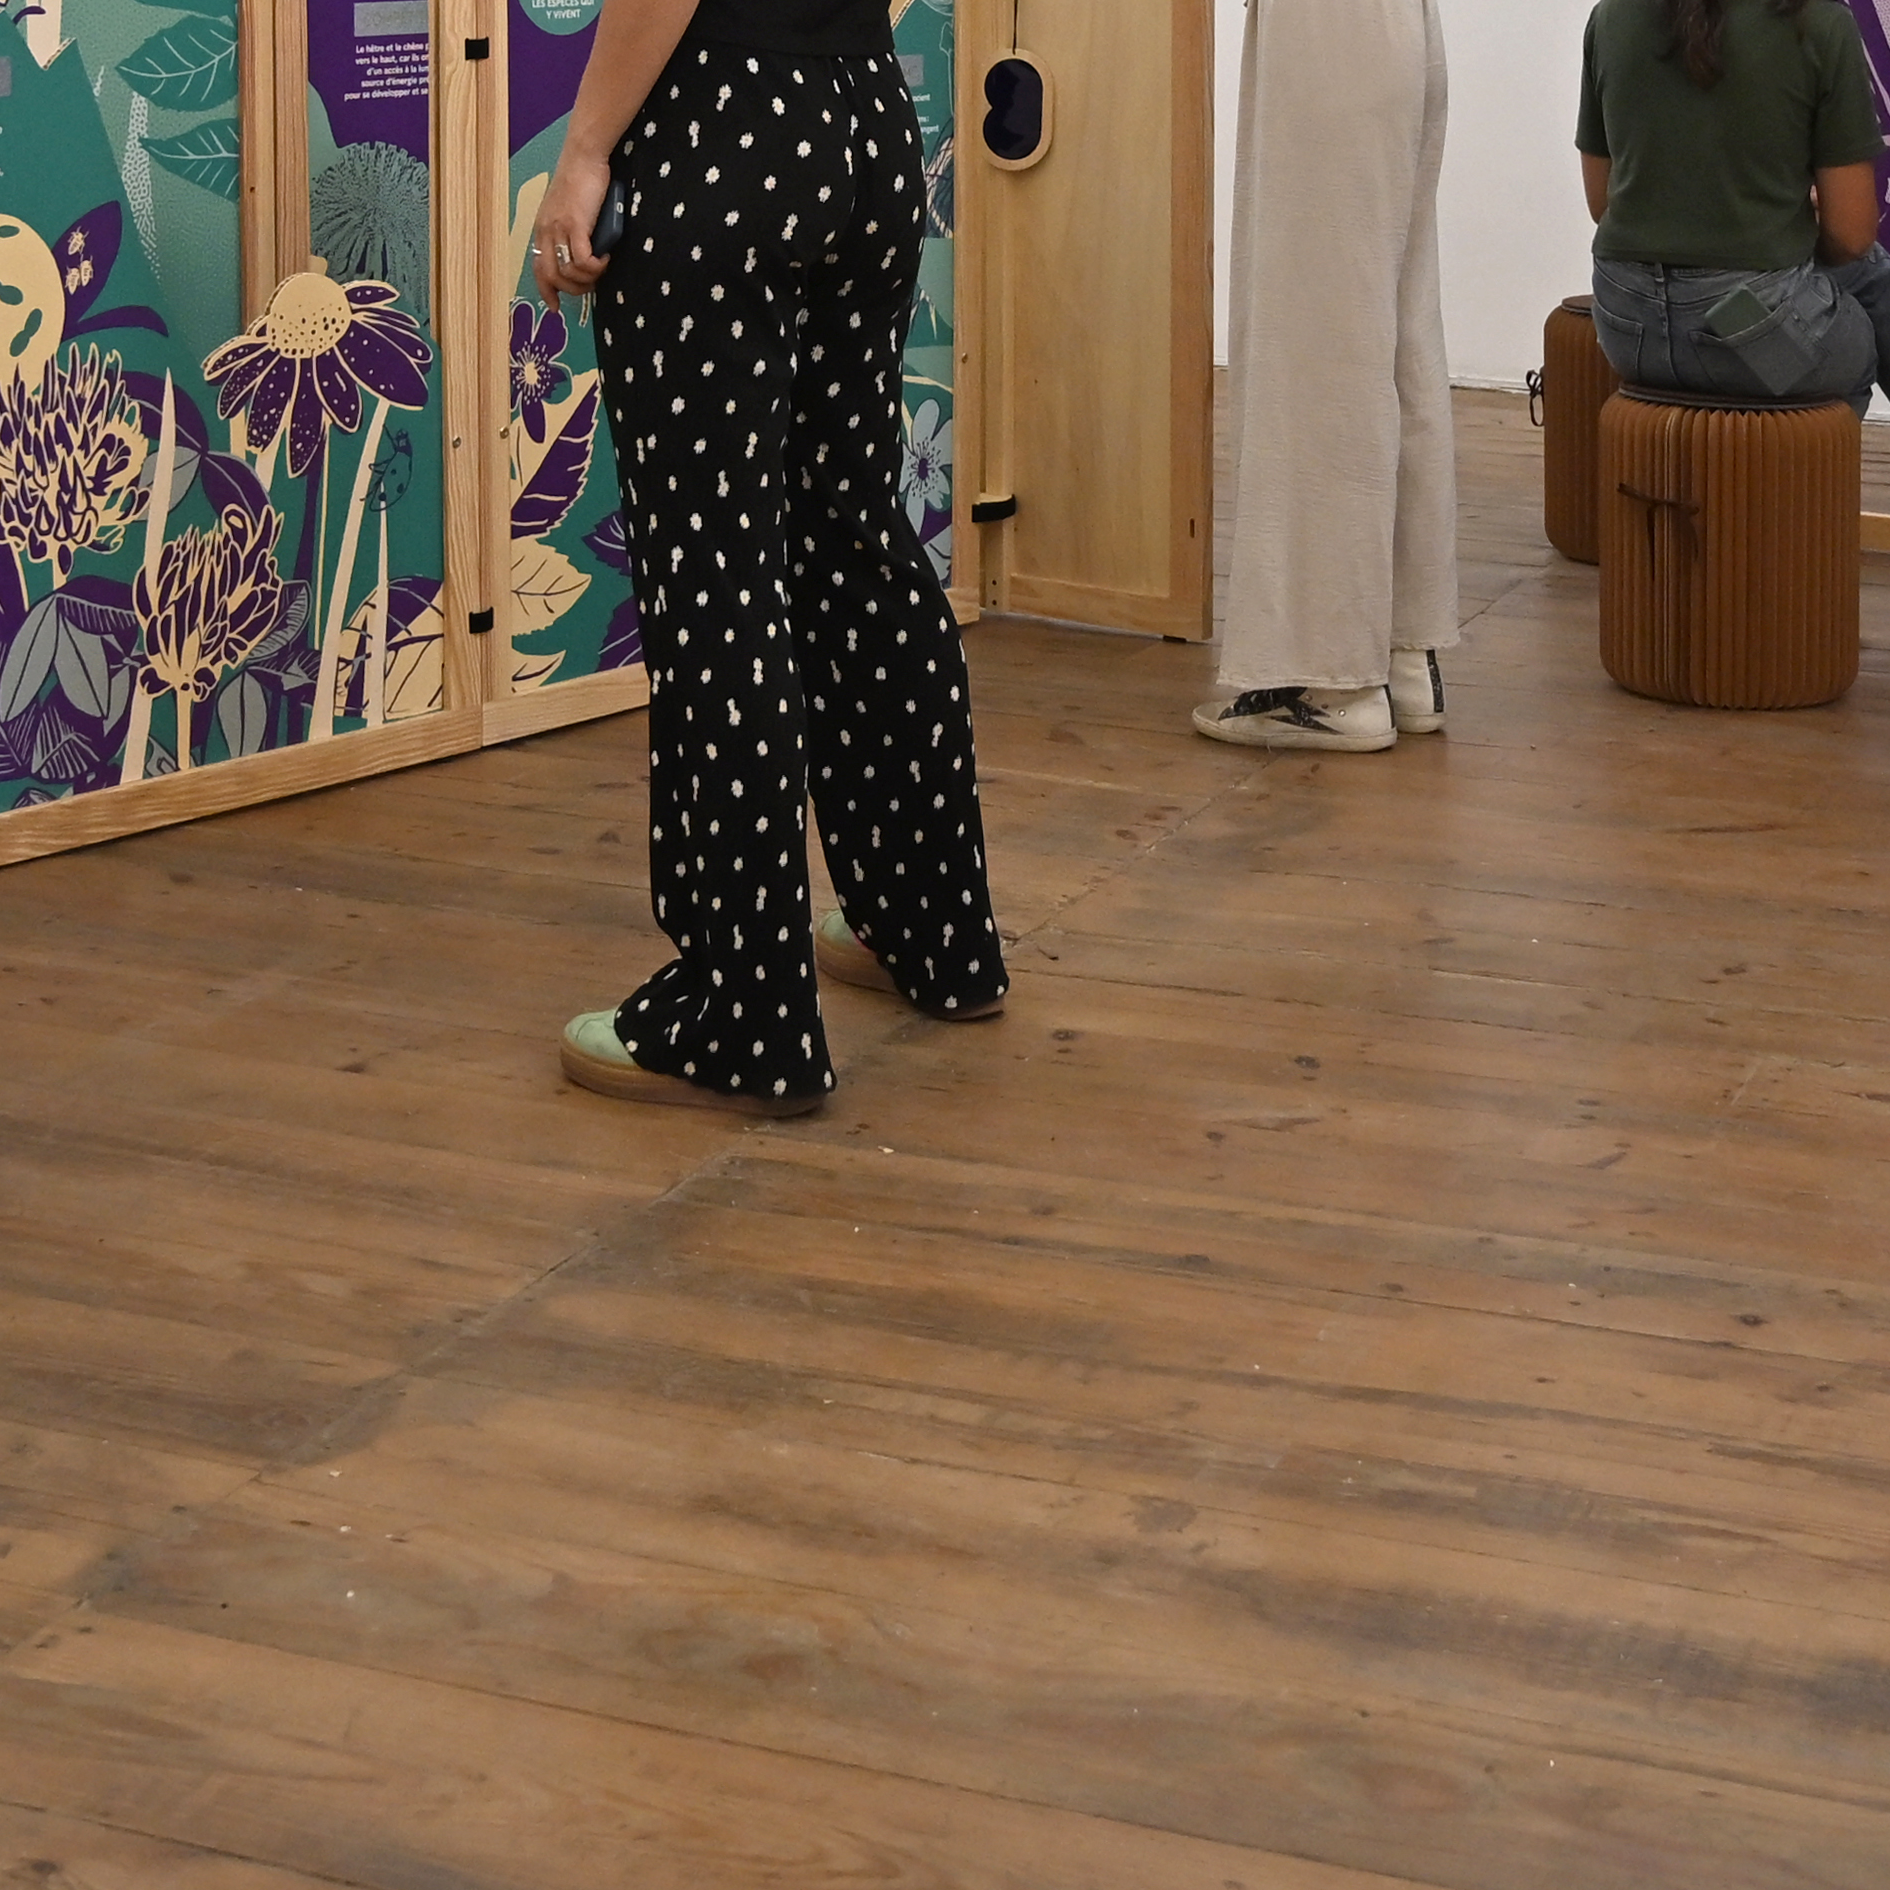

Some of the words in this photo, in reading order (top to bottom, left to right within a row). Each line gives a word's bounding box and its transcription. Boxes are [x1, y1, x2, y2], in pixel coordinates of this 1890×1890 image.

[532, 0, 546, 8] LES
[546, 11, 552, 19] Y
[553, 9, 581, 19] VIVENT
